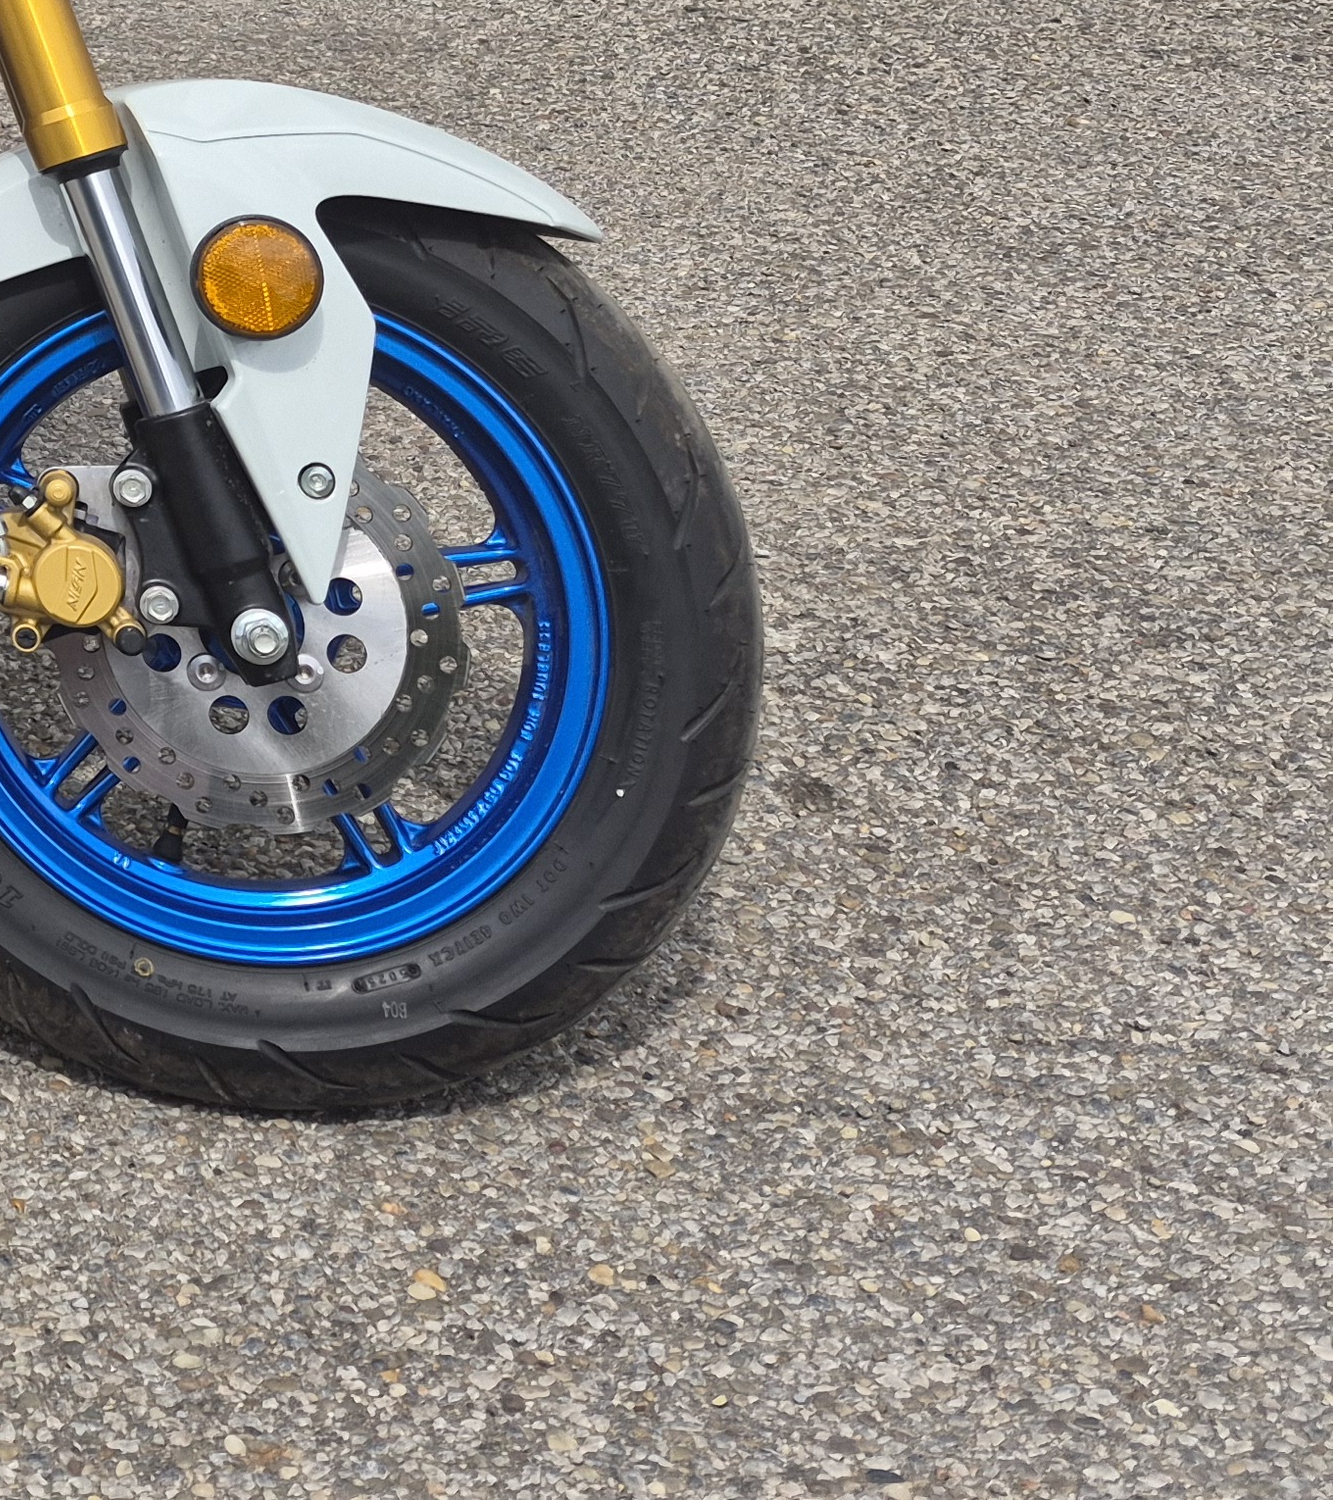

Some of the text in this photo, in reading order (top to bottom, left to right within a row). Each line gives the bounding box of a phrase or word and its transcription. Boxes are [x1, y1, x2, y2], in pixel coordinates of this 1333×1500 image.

[626, 684, 660, 778] ROTATION
[534, 860, 567, 893] DOT
[62, 930, 98, 955] COLD
[175, 992, 213, 1008] LOAD
[186, 983, 212, 997] 175
[219, 991, 236, 1001] AT
